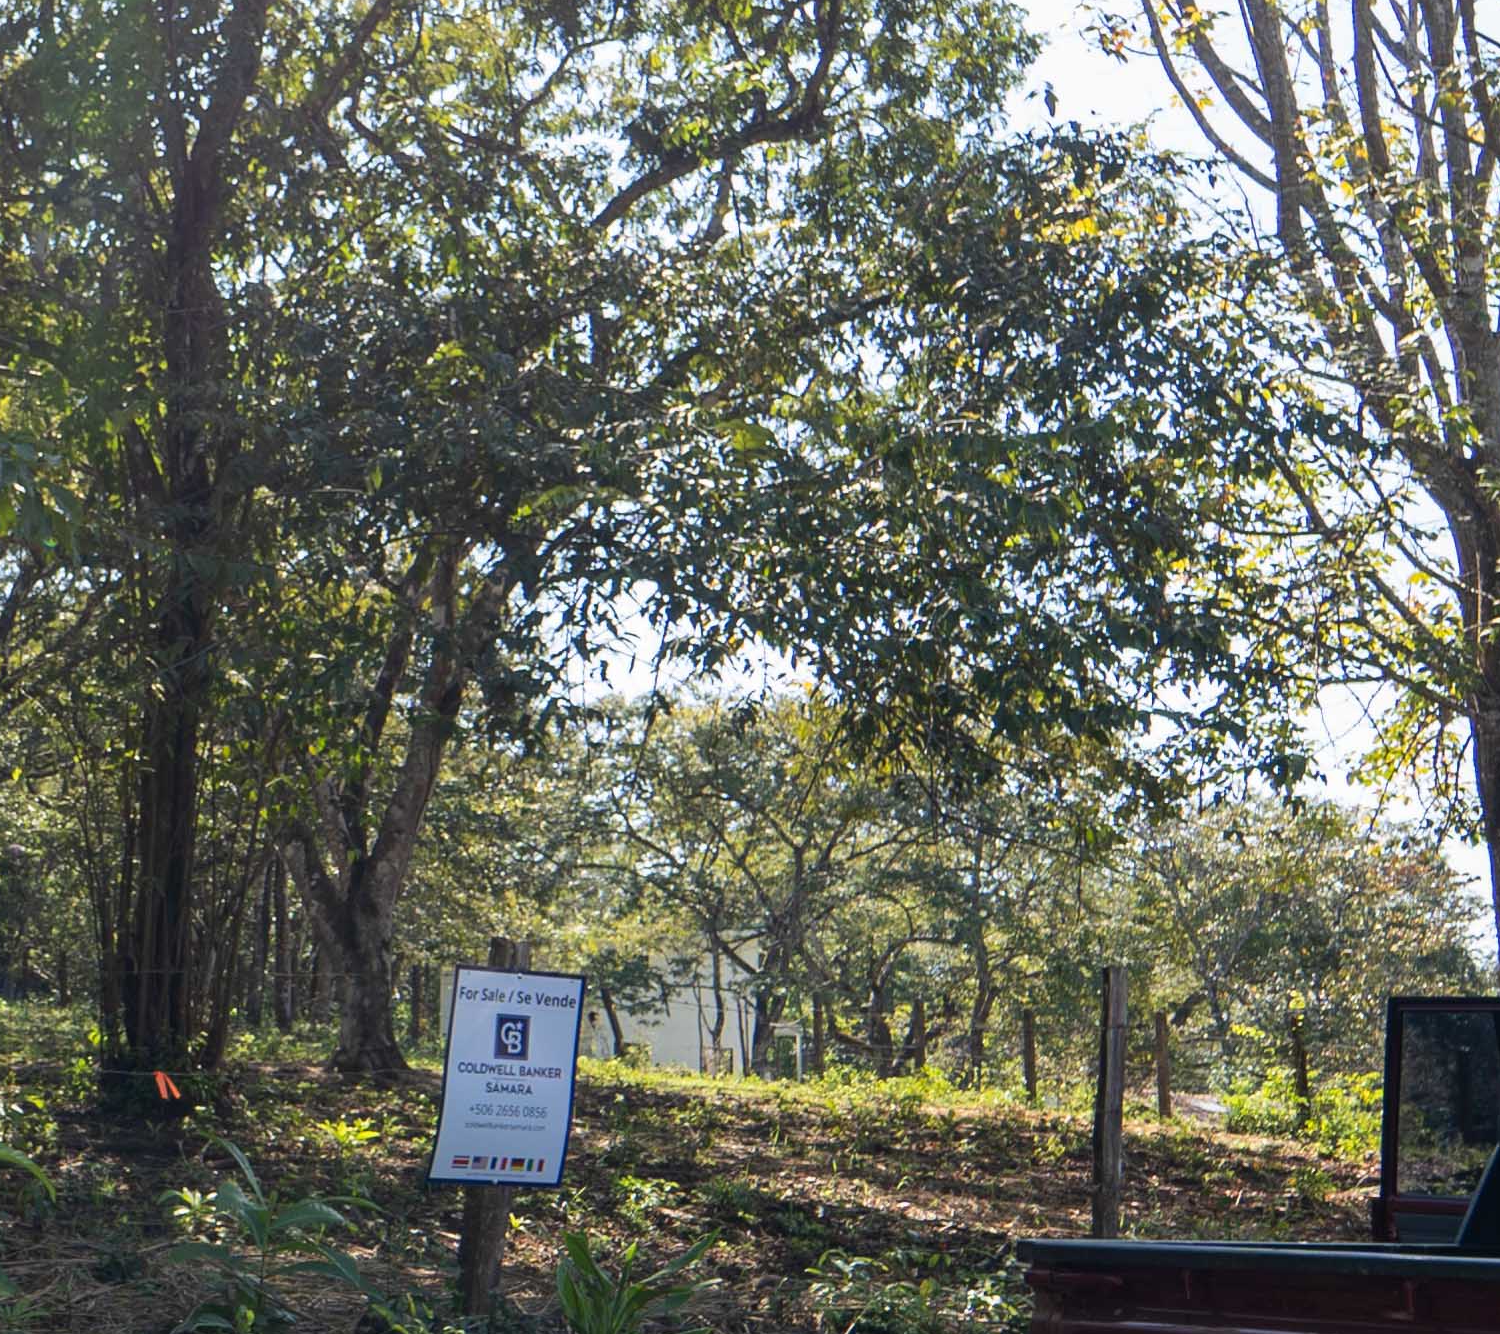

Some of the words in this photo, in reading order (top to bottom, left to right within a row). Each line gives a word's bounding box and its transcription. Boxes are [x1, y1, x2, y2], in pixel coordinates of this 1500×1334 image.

[459, 986, 479, 1001] For
[481, 987, 506, 1003] Sale
[508, 989, 515, 1003] /
[516, 990, 532, 1005] Se
[534, 992, 577, 1008] Vende
[457, 1061, 516, 1076] COLDWELL
[518, 1065, 562, 1080] BANKER
[469, 1103, 494, 1115] +506
[495, 1104, 521, 1117] 2656
